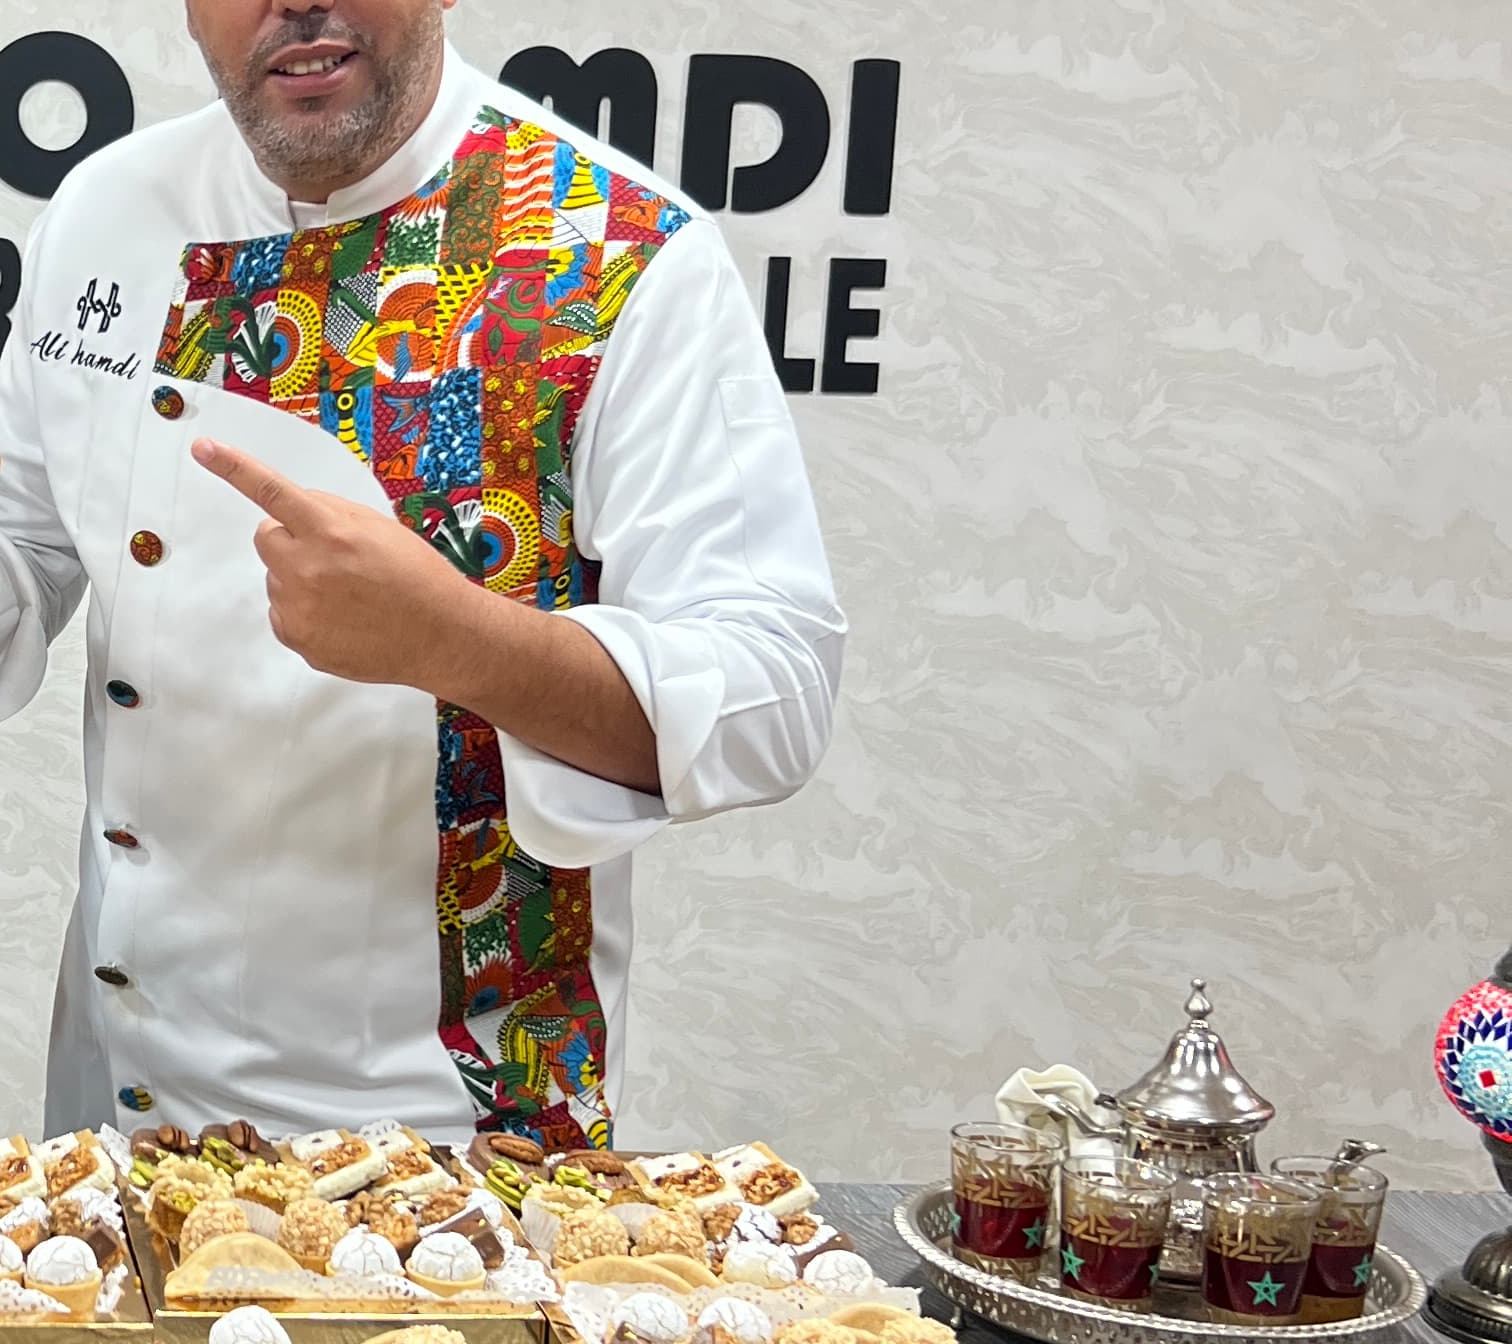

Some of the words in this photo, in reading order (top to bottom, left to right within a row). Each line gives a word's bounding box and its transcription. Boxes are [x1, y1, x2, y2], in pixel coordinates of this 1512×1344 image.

[498, 45, 901, 216] MDI
[30, 330, 69, 362] Ali
[70, 338, 141, 380] hamdi
